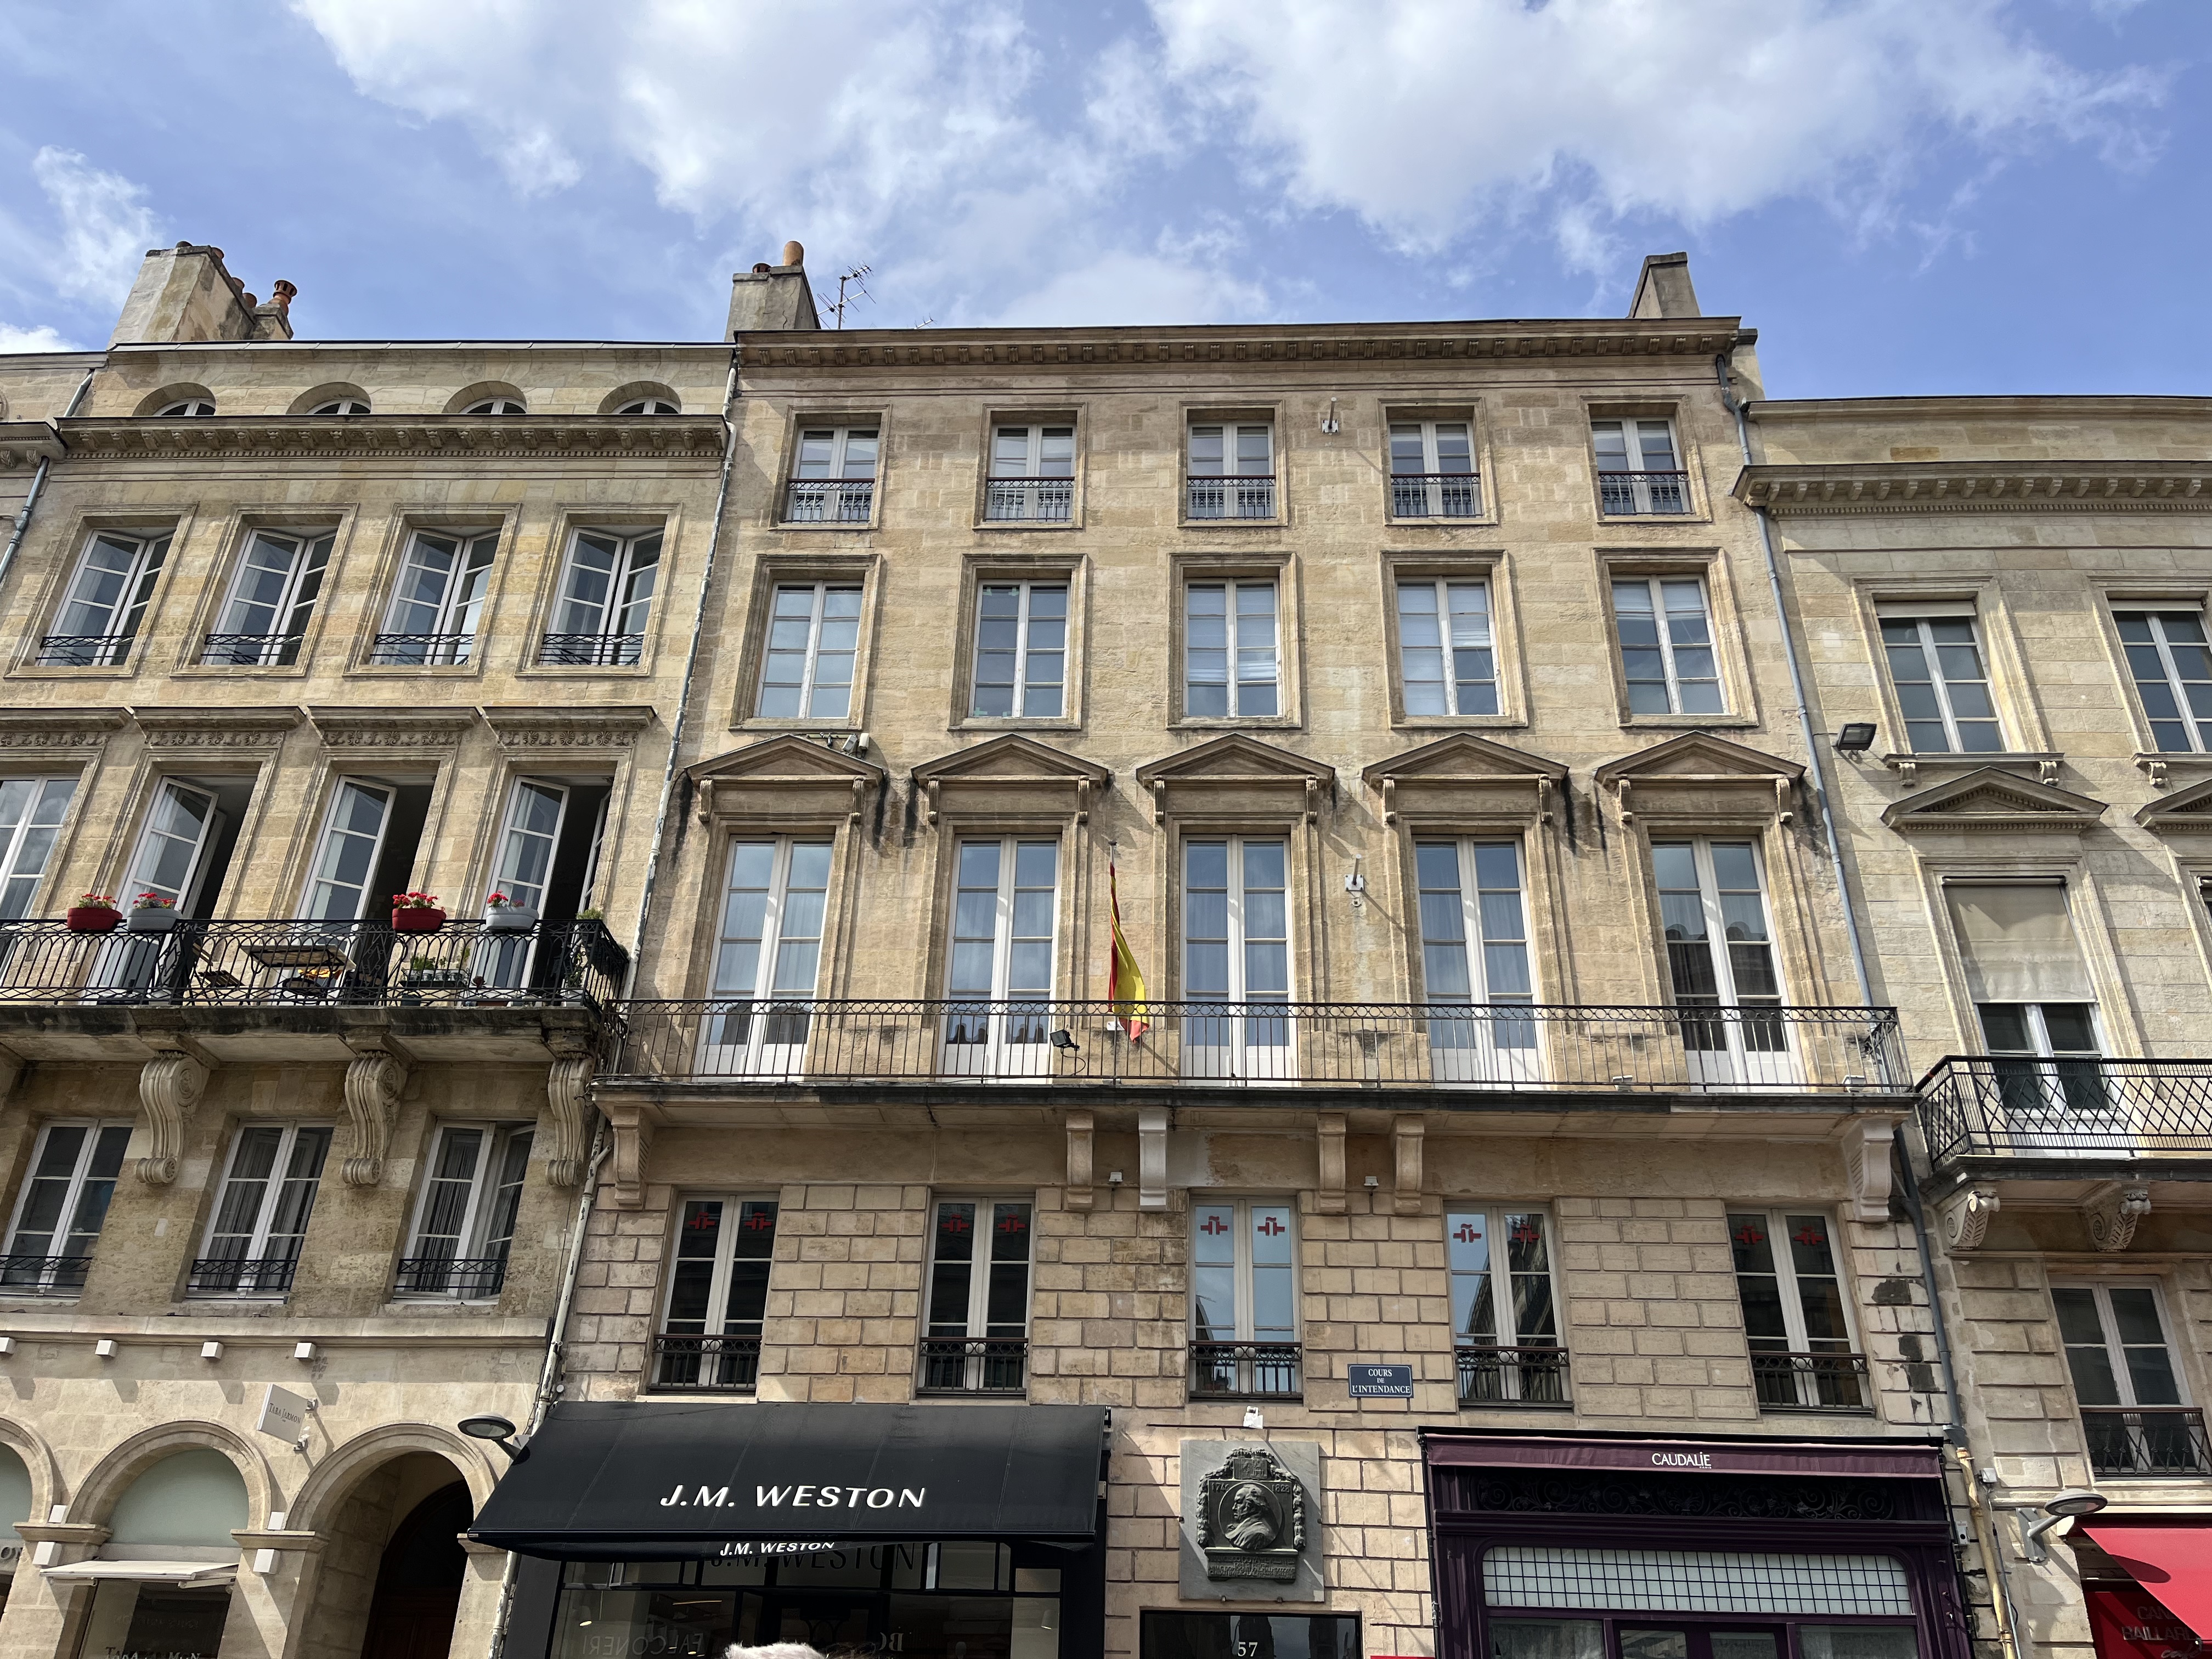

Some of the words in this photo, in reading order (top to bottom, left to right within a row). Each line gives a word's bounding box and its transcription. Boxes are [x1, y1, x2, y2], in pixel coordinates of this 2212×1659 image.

[1352, 1385, 1410, 1393] L'INTENDANCE
[269, 1402, 281, 1416] TARA
[280, 1408, 301, 1424] JARMON
[1211, 1482, 1229, 1492] 1746
[1272, 1483, 1290, 1493] 1828
[660, 1485, 736, 1508] J.M.
[756, 1485, 925, 1508] WESTON
[720, 1542, 753, 1556] J.M.
[760, 1542, 835, 1553] WESTON
[1237, 1641, 1258, 1657] 57
